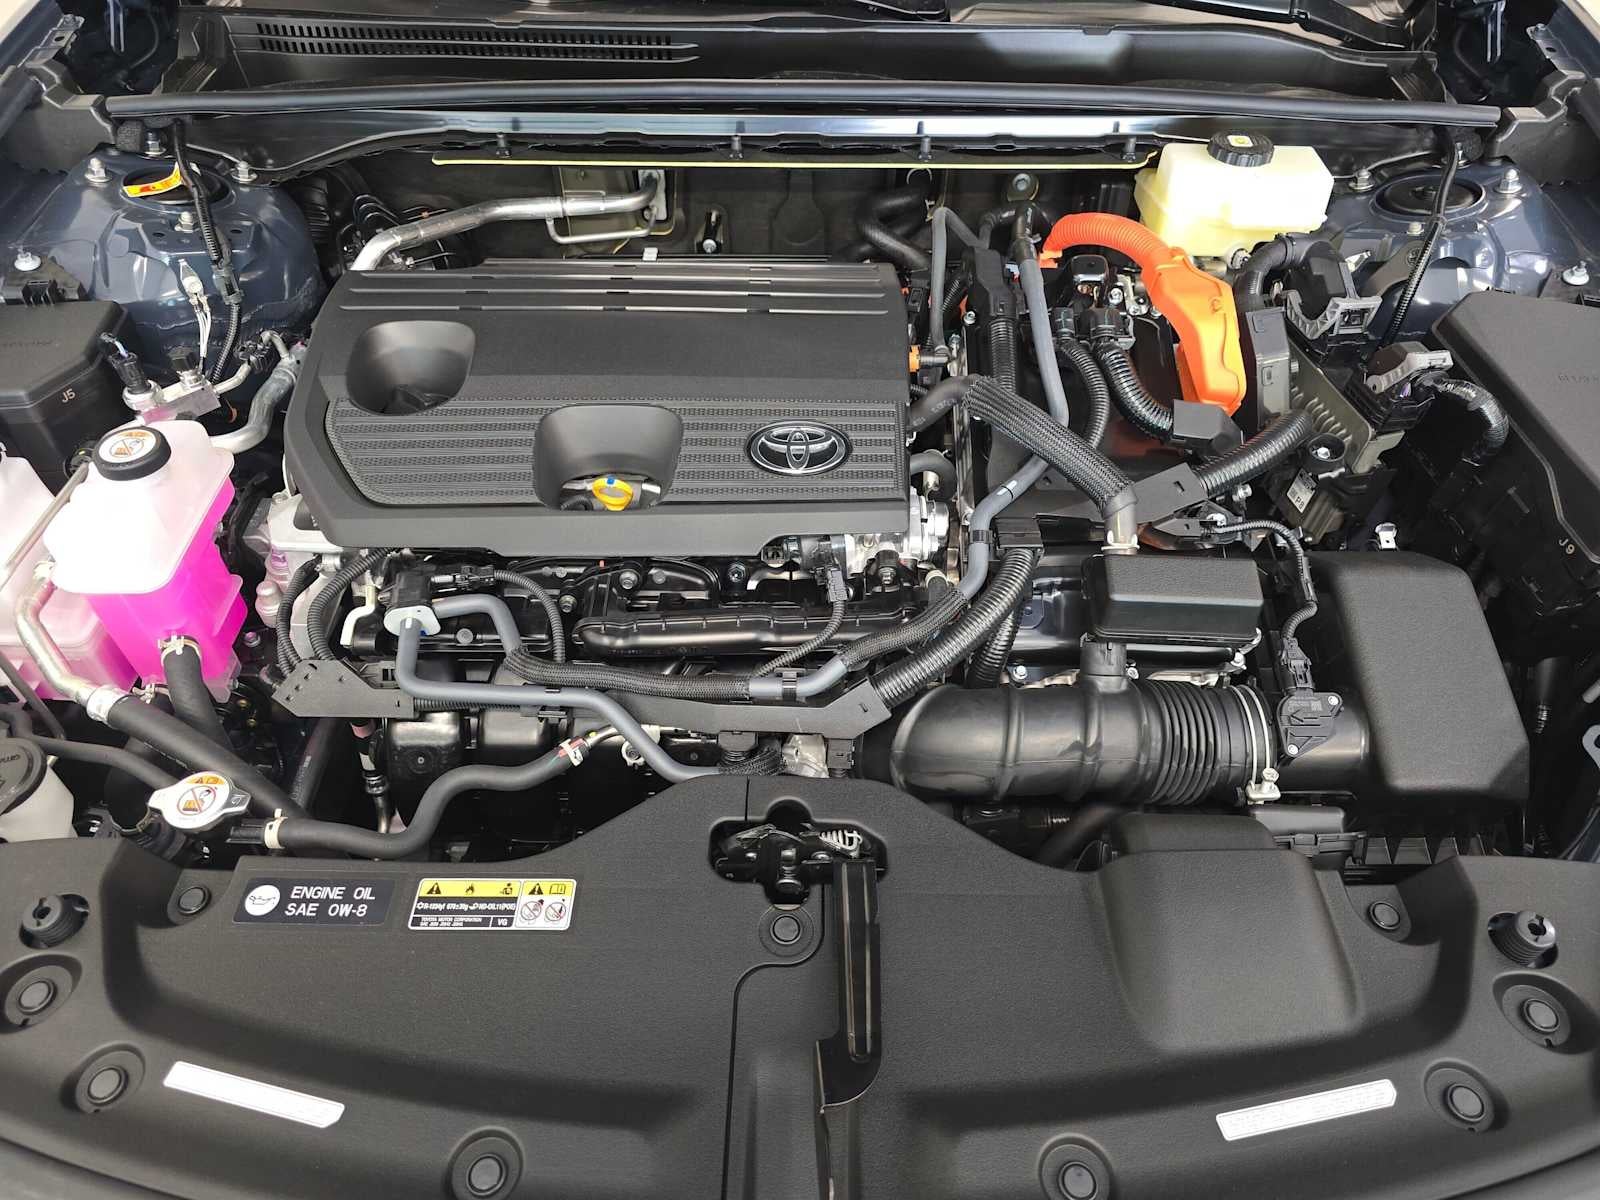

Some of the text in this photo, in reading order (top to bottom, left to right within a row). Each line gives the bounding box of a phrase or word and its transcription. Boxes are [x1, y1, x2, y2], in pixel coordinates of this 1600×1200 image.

[62, 388, 76, 403] J5
[1558, 538, 1575, 554] J9
[290, 886, 376, 900] ENGINE OIL
[284, 902, 368, 917] SAE 0W-8
[497, 917, 508, 926] VG
